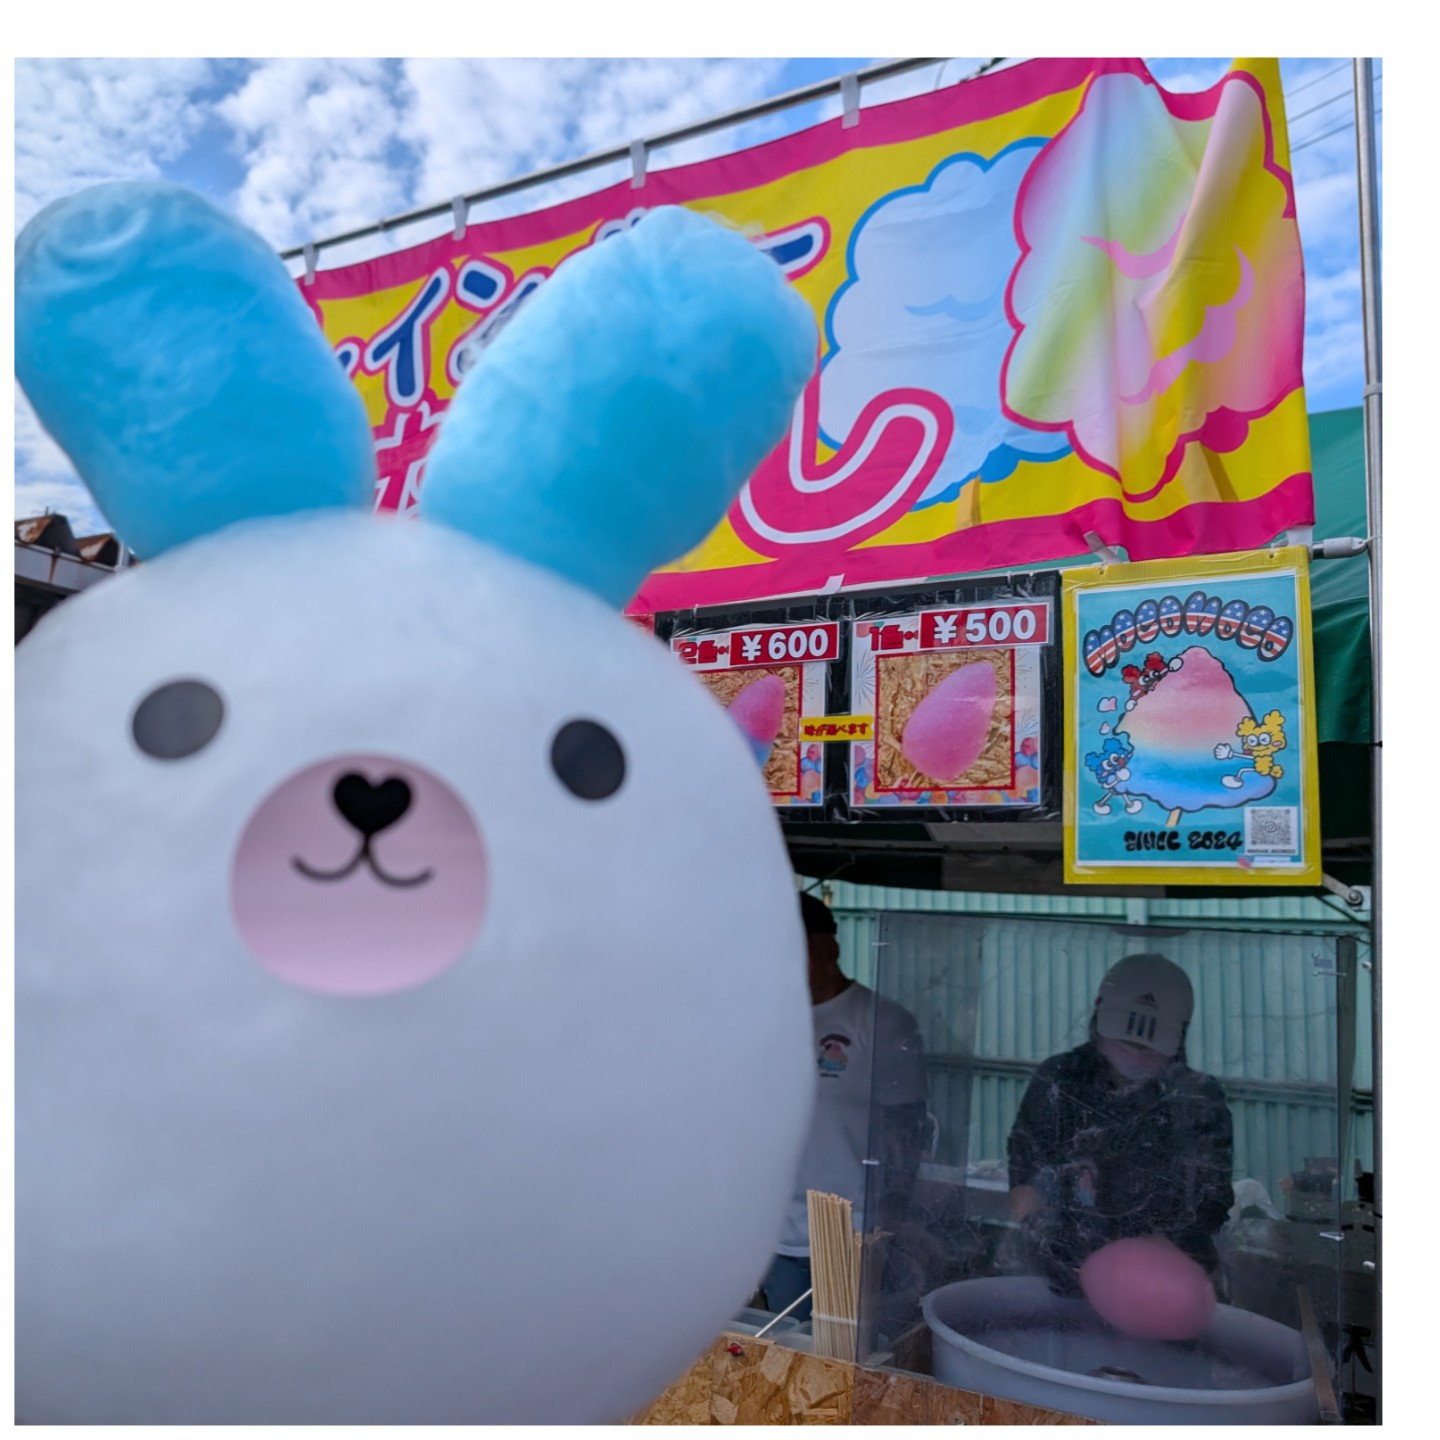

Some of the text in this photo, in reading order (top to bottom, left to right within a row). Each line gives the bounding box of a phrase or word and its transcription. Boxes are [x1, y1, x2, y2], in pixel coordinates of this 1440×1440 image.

[933, 608, 1037, 644] ¥500
[741, 627, 829, 661] ¥600
[1124, 829, 1243, 852] SINCE 2024
